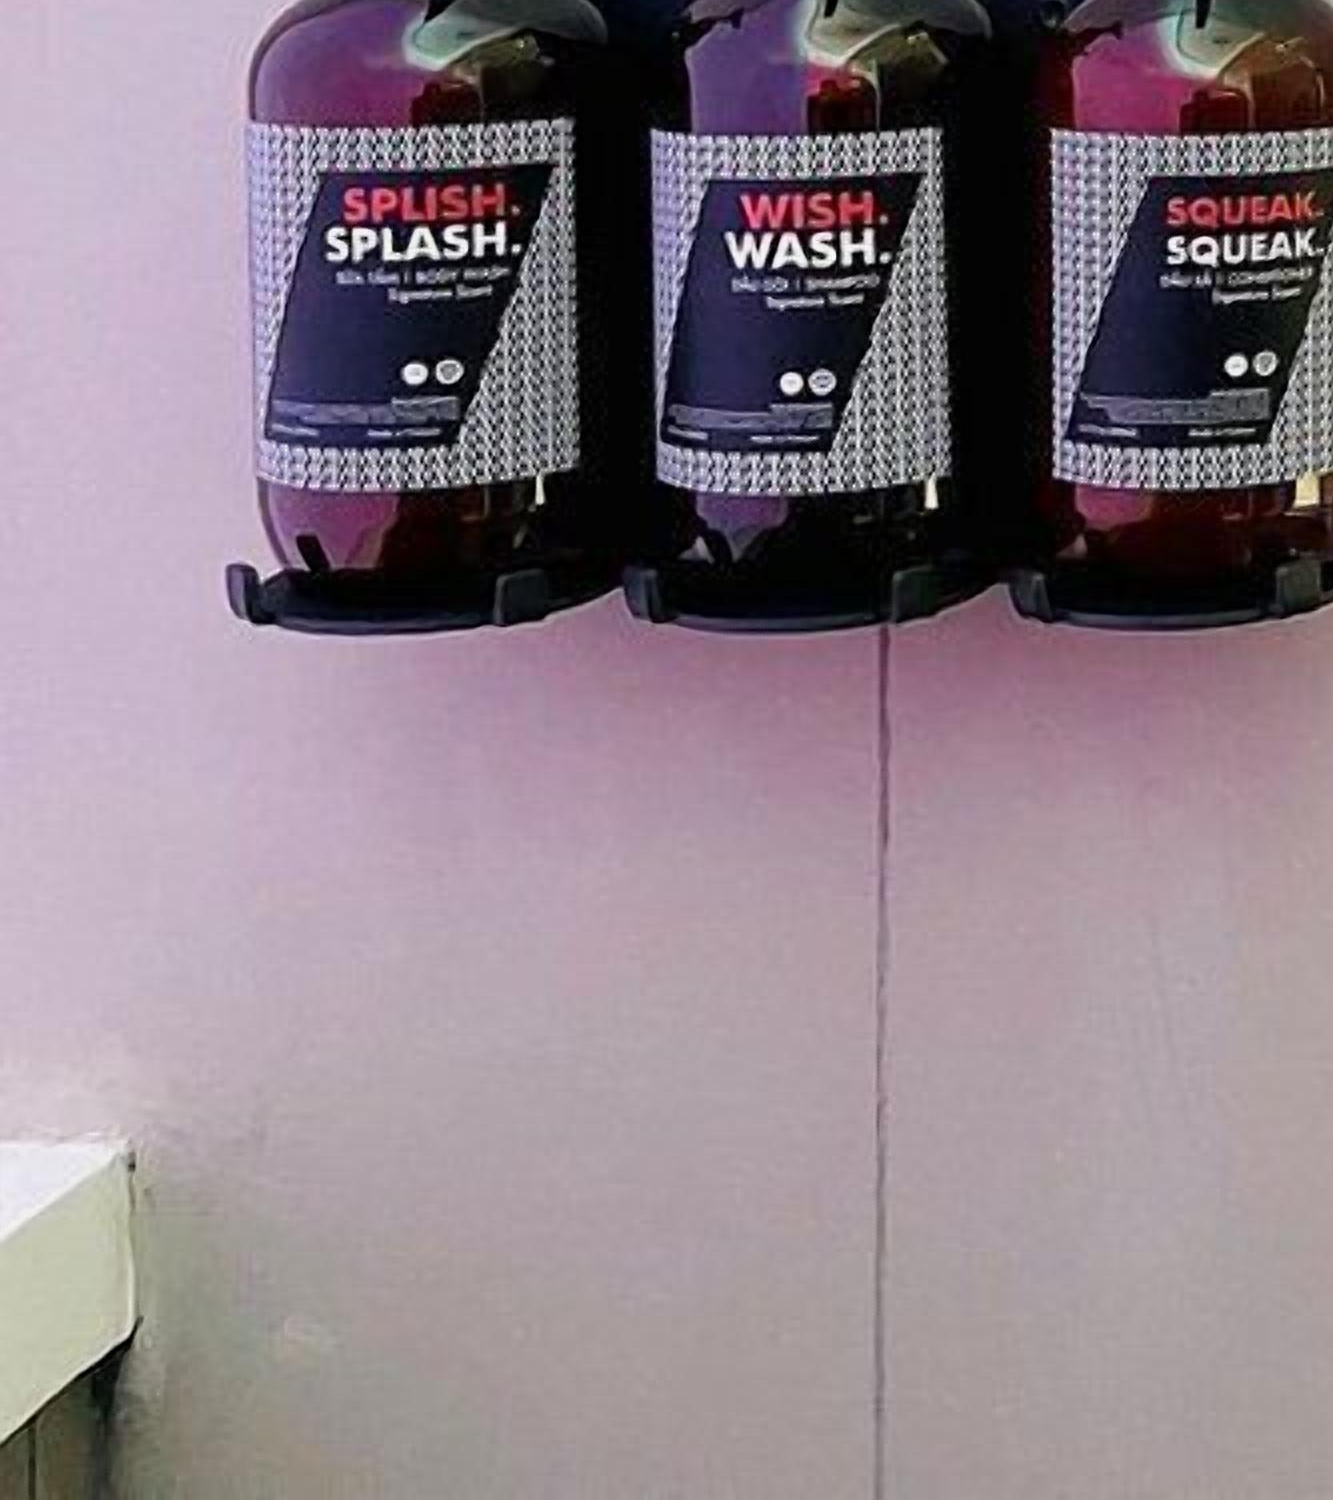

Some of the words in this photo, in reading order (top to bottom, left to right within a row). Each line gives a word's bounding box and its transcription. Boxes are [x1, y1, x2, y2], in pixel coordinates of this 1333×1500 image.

[343, 183, 521, 224] SPLISH.
[740, 190, 889, 230] WISH.
[1166, 190, 1325, 229] SQUEAK.
[325, 221, 522, 262] SPLASH.
[724, 228, 892, 270] WASH.
[1166, 226, 1326, 269] SQUEAK.
